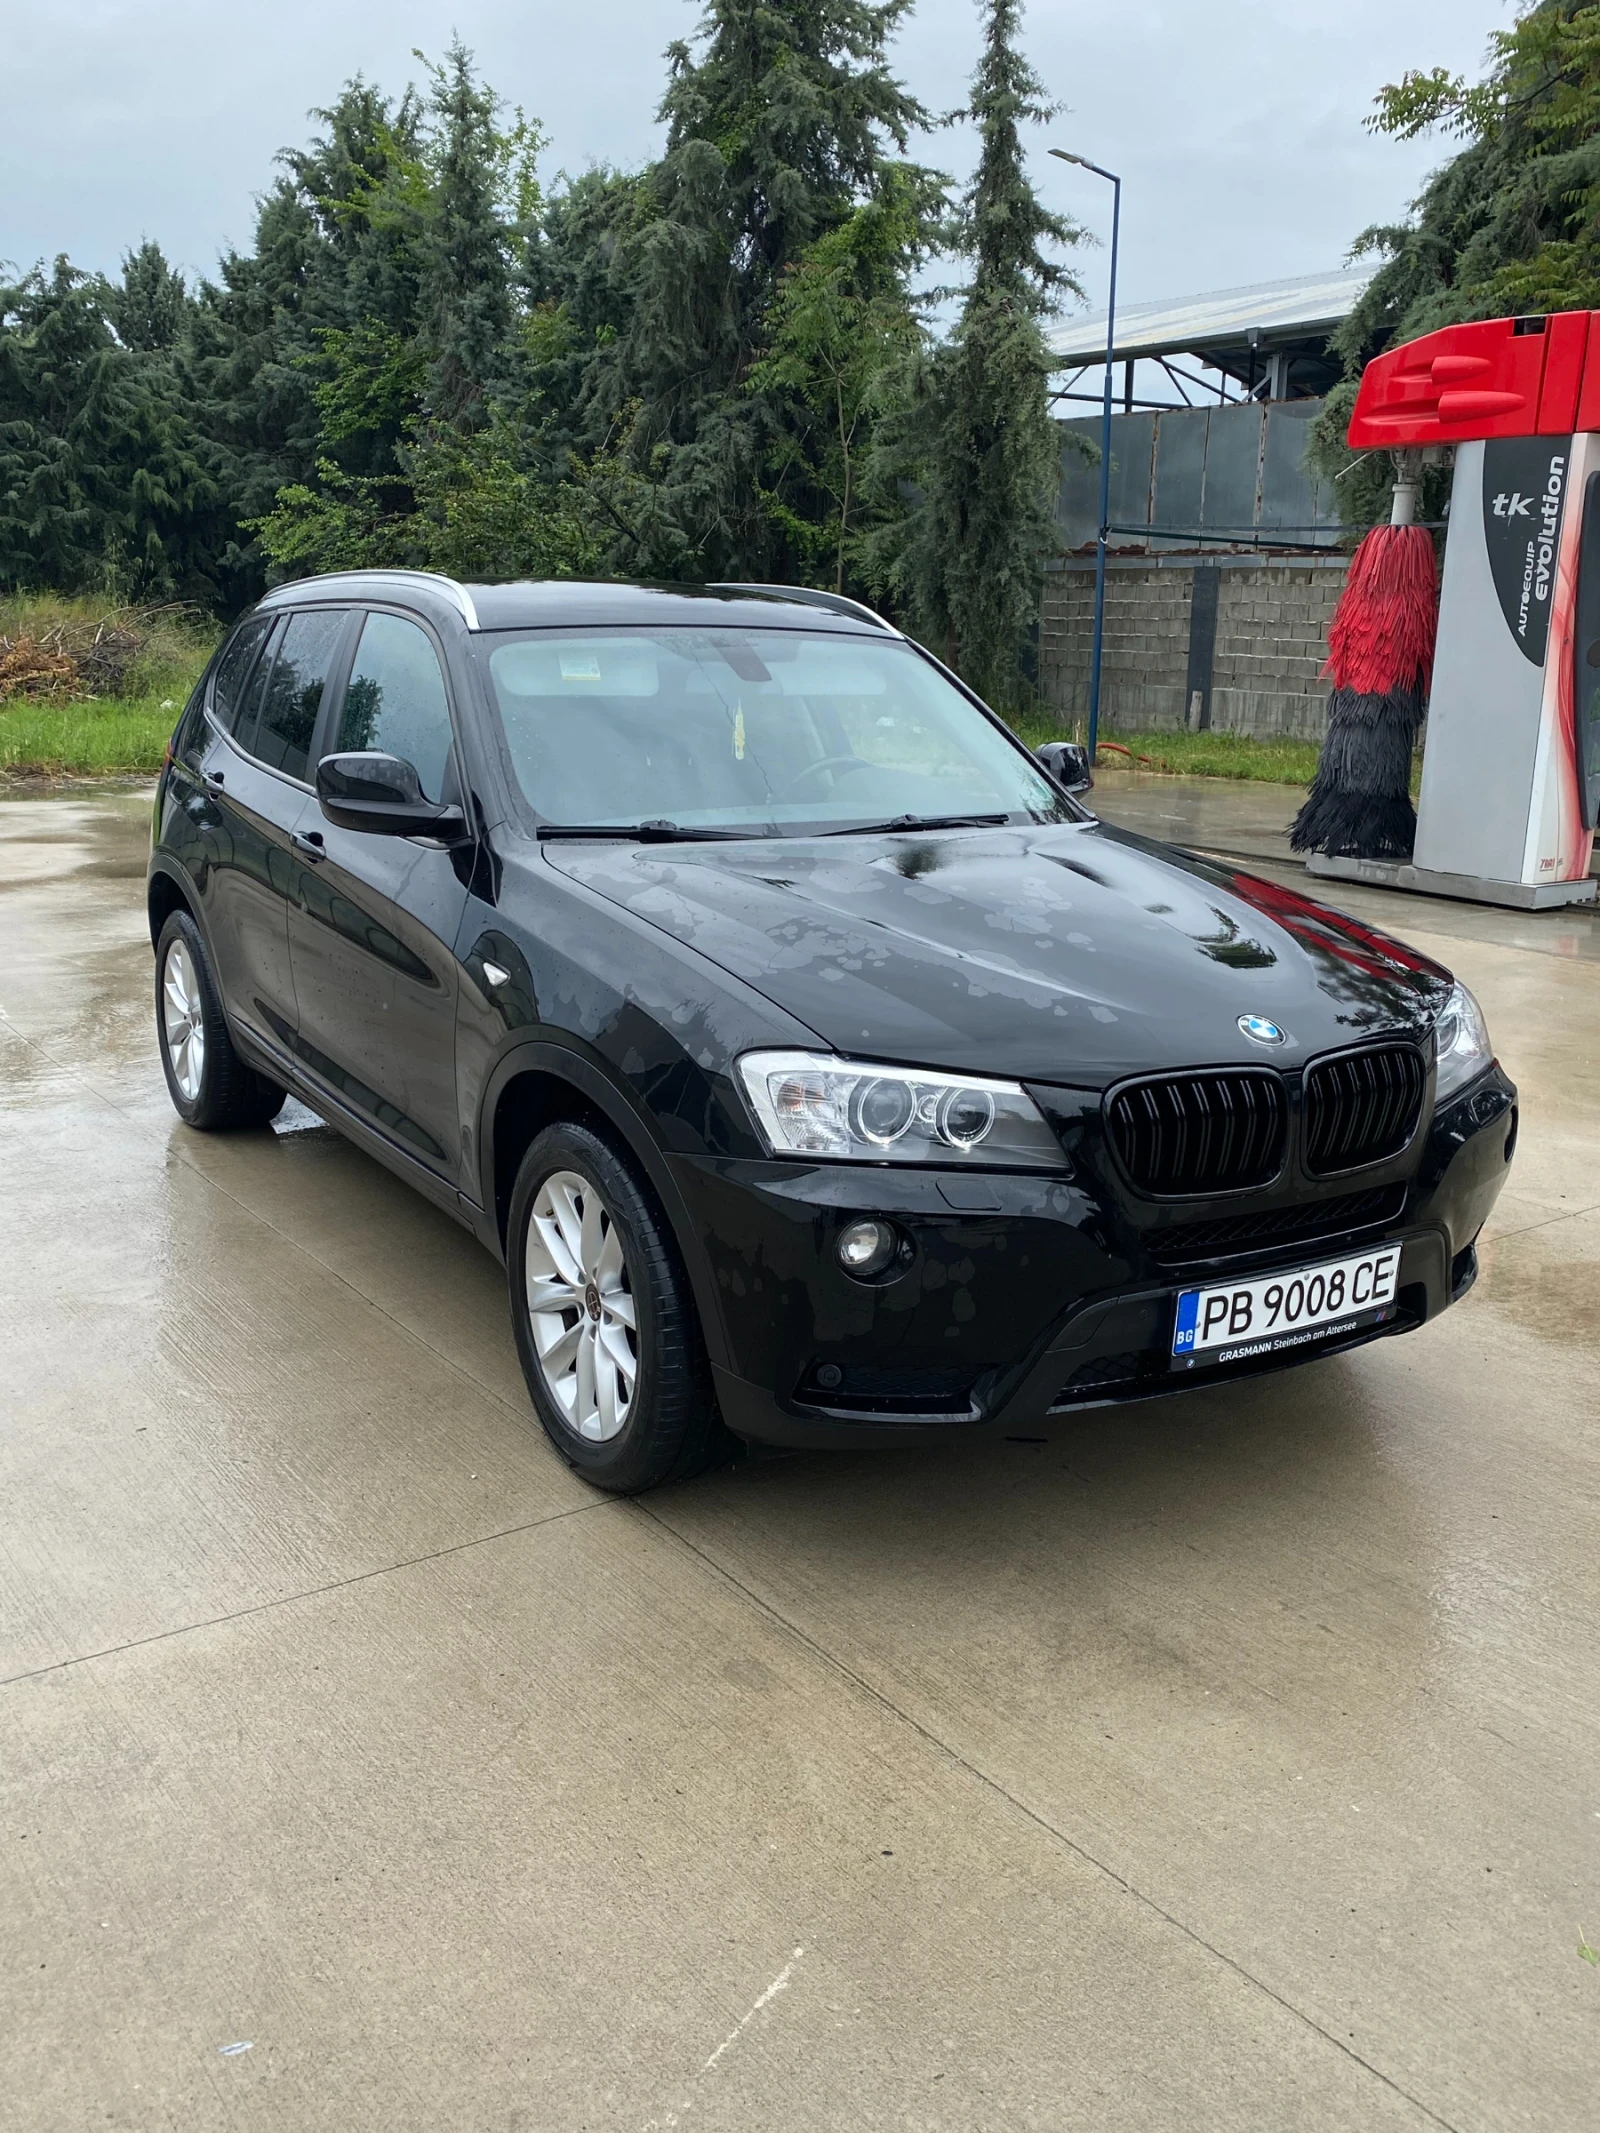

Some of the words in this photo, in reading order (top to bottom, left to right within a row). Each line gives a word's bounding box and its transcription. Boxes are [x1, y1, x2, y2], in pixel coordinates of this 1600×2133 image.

[1492, 493, 1535, 516] tk
[1518, 540, 1535, 637] AUTOEQUIP
[1201, 1290, 1253, 1341] PB
[1263, 1269, 1346, 1328] 9008
[1351, 1254, 1394, 1304] CE
[1176, 1329, 1193, 1345] BG
[1219, 1341, 1272, 1362] GRASMANN
[1273, 1333, 1312, 1350] Steinbach
[1312, 1330, 1325, 1340] am
[1325, 1321, 1357, 1337] Attersee
